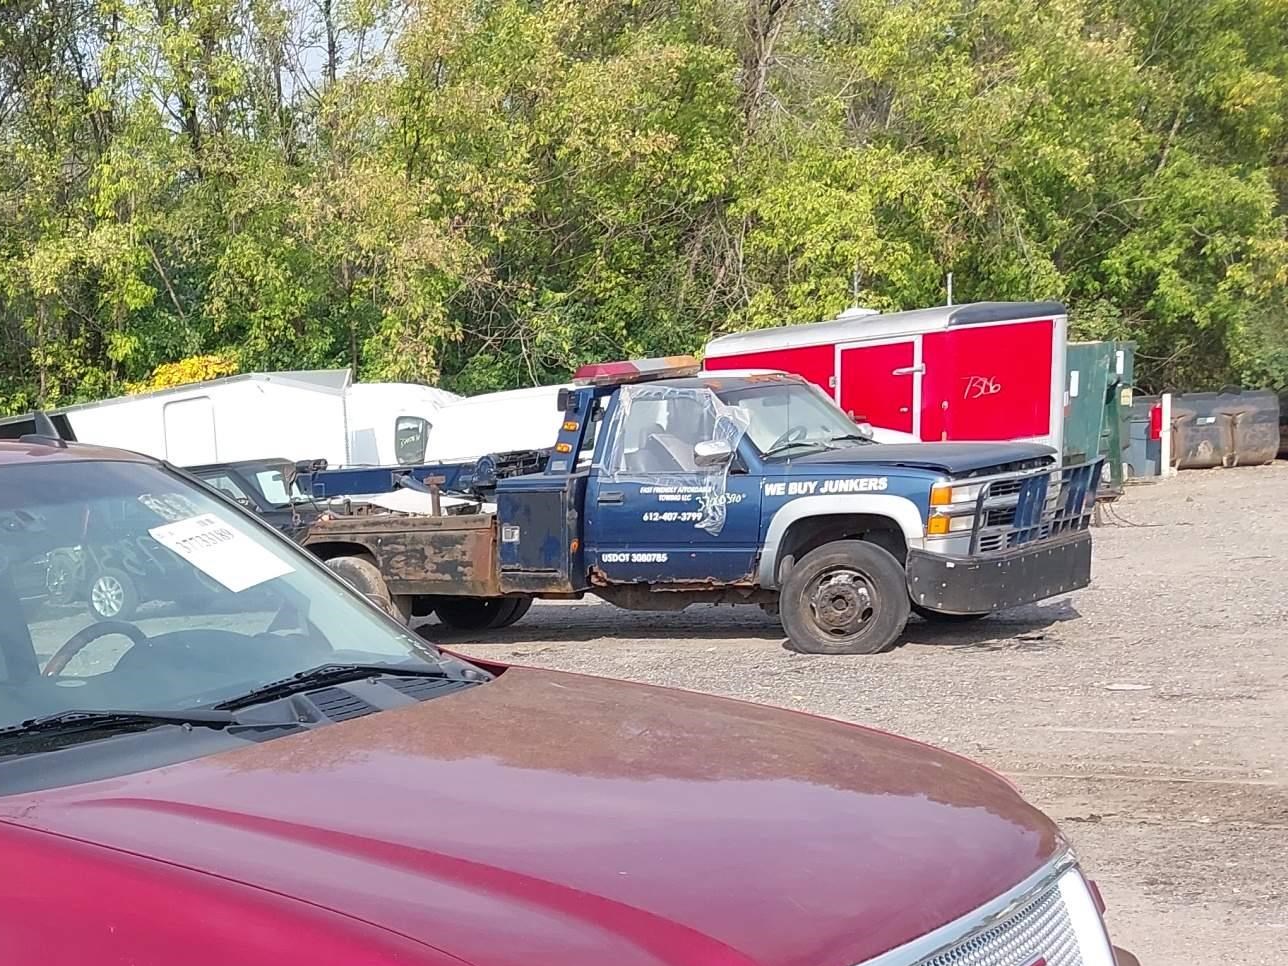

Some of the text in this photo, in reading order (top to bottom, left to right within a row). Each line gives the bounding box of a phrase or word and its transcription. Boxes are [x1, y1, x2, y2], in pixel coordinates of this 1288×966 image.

[764, 477, 888, 496] WE BUY JUNKERS
[642, 511, 703, 522] 612-407-3799
[601, 552, 631, 563] USDOT
